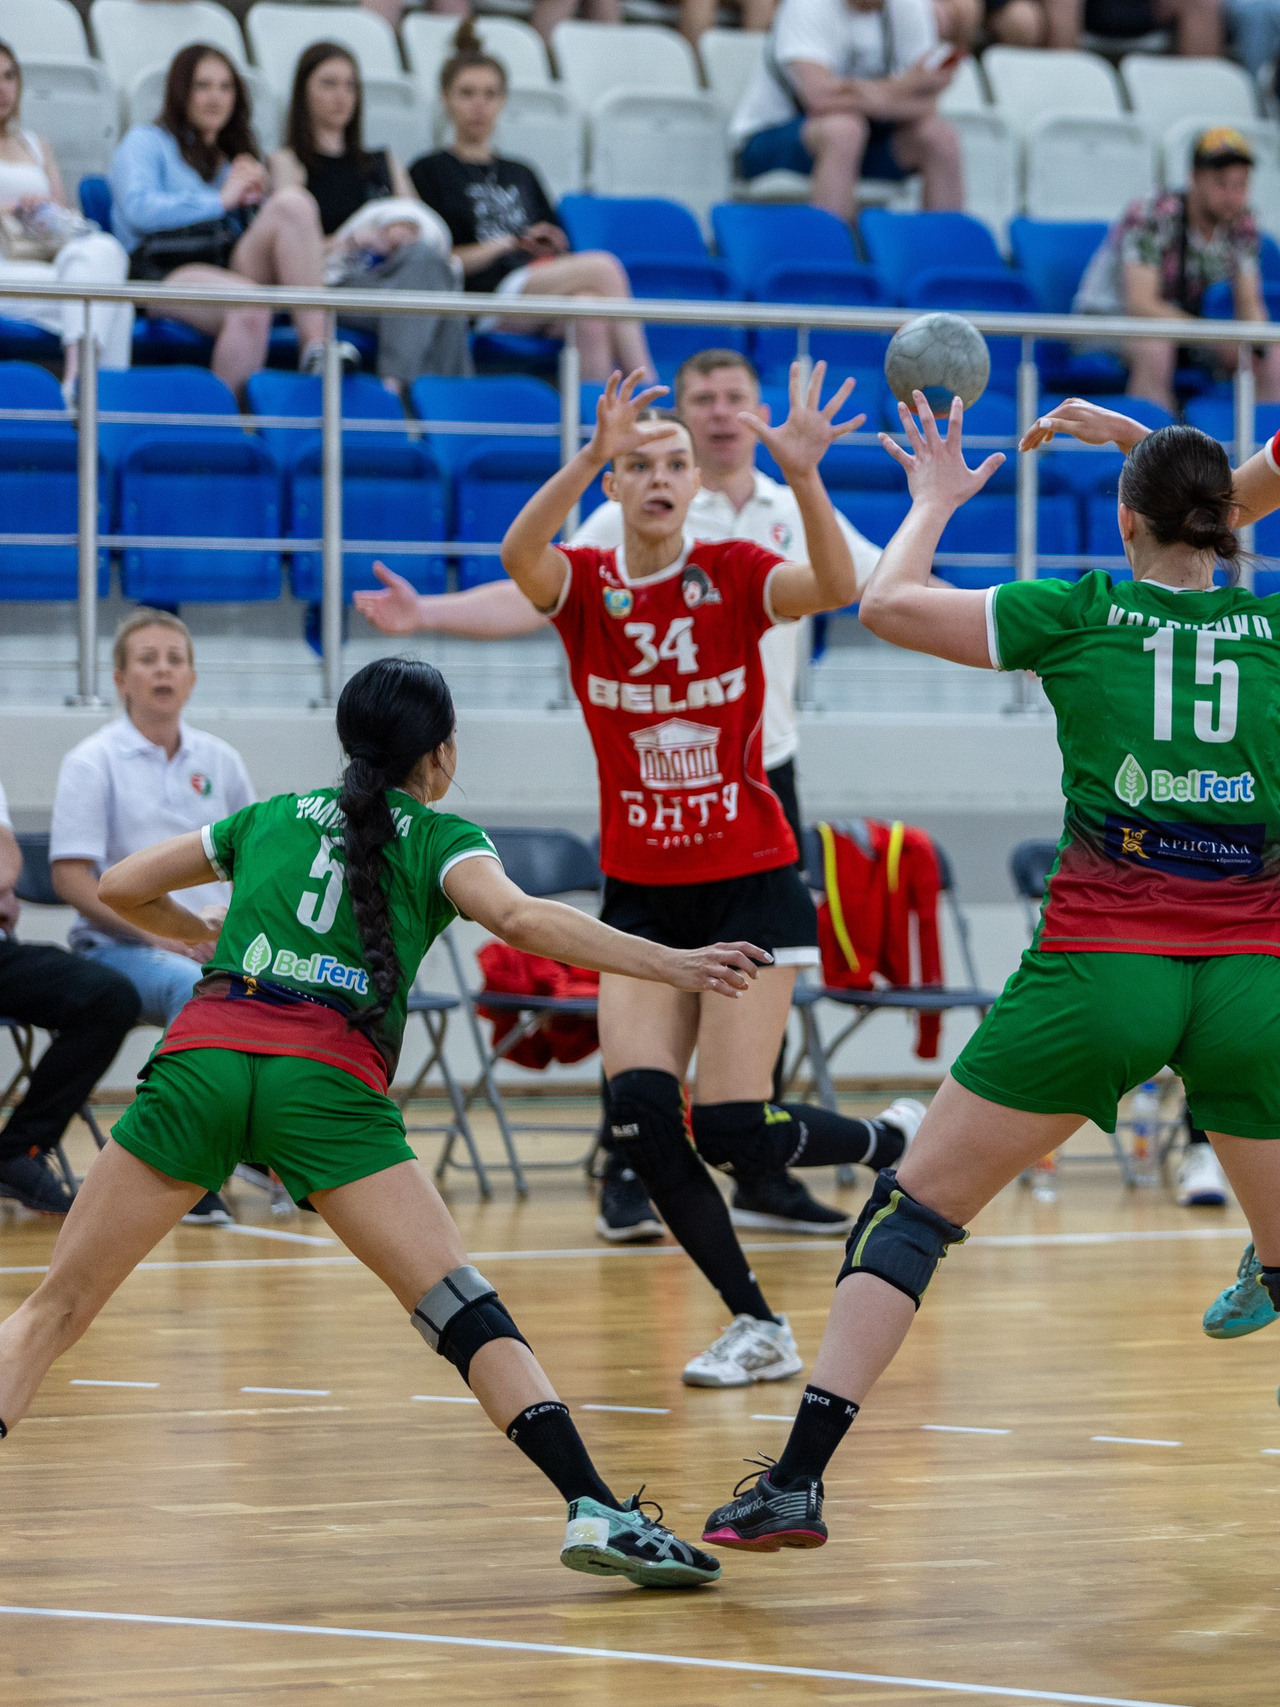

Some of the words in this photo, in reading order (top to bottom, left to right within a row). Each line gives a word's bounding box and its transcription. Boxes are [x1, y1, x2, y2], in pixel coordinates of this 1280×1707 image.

[624, 616, 699, 676] 34
[587, 665, 746, 714] BELAZ
[1143, 627, 1241, 743] 15
[1152, 769, 1254, 802] BelFert
[296, 834, 346, 934] 5
[273, 950, 369, 994] BelFert
